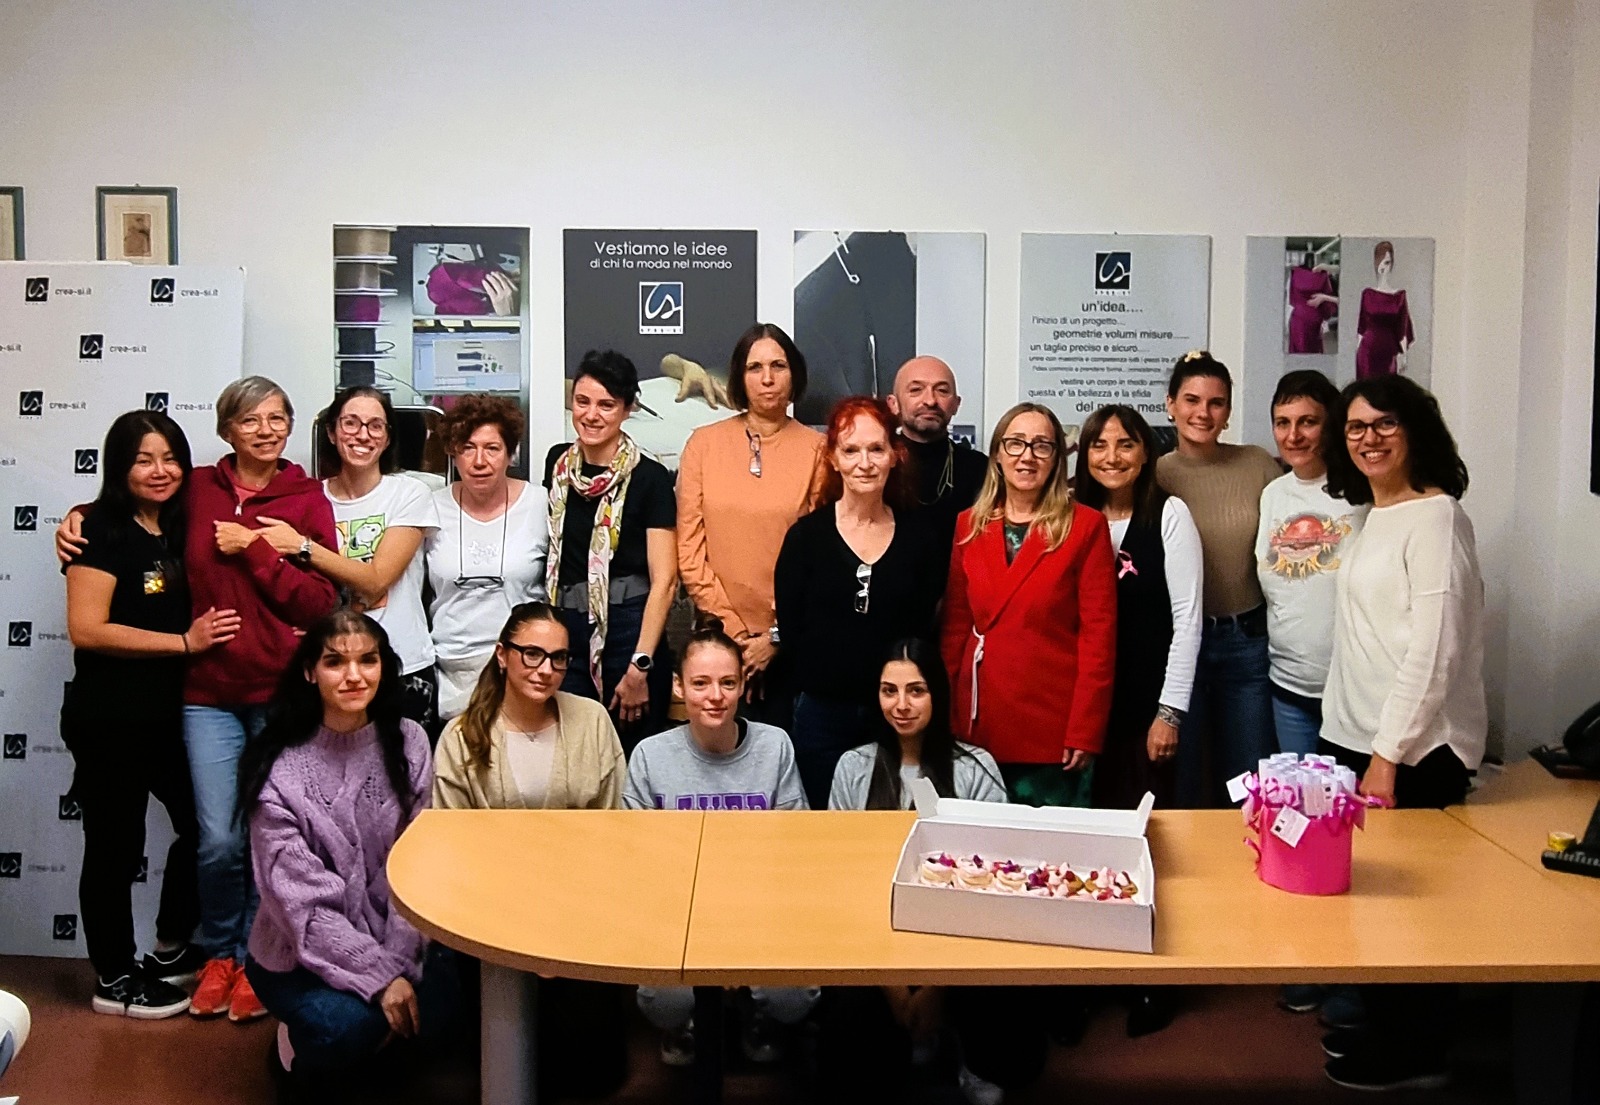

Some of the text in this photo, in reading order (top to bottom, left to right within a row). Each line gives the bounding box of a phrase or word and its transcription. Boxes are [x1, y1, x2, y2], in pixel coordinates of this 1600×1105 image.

[594, 241, 728, 256] Vestiamo le idee
[590, 258, 733, 269] di chi fa moda nel mondo
[1053, 329, 1102, 340] geometrie
[1105, 329, 1137, 339] volumi
[1044, 343, 1068, 353] taglio
[1069, 343, 1101, 353] preciso
[1028, 389, 1056, 397] questa
[1068, 389, 1076, 397] la
[1078, 389, 1112, 397] bellezza
[1122, 389, 1129, 397] la
[1076, 401, 1094, 412] del
